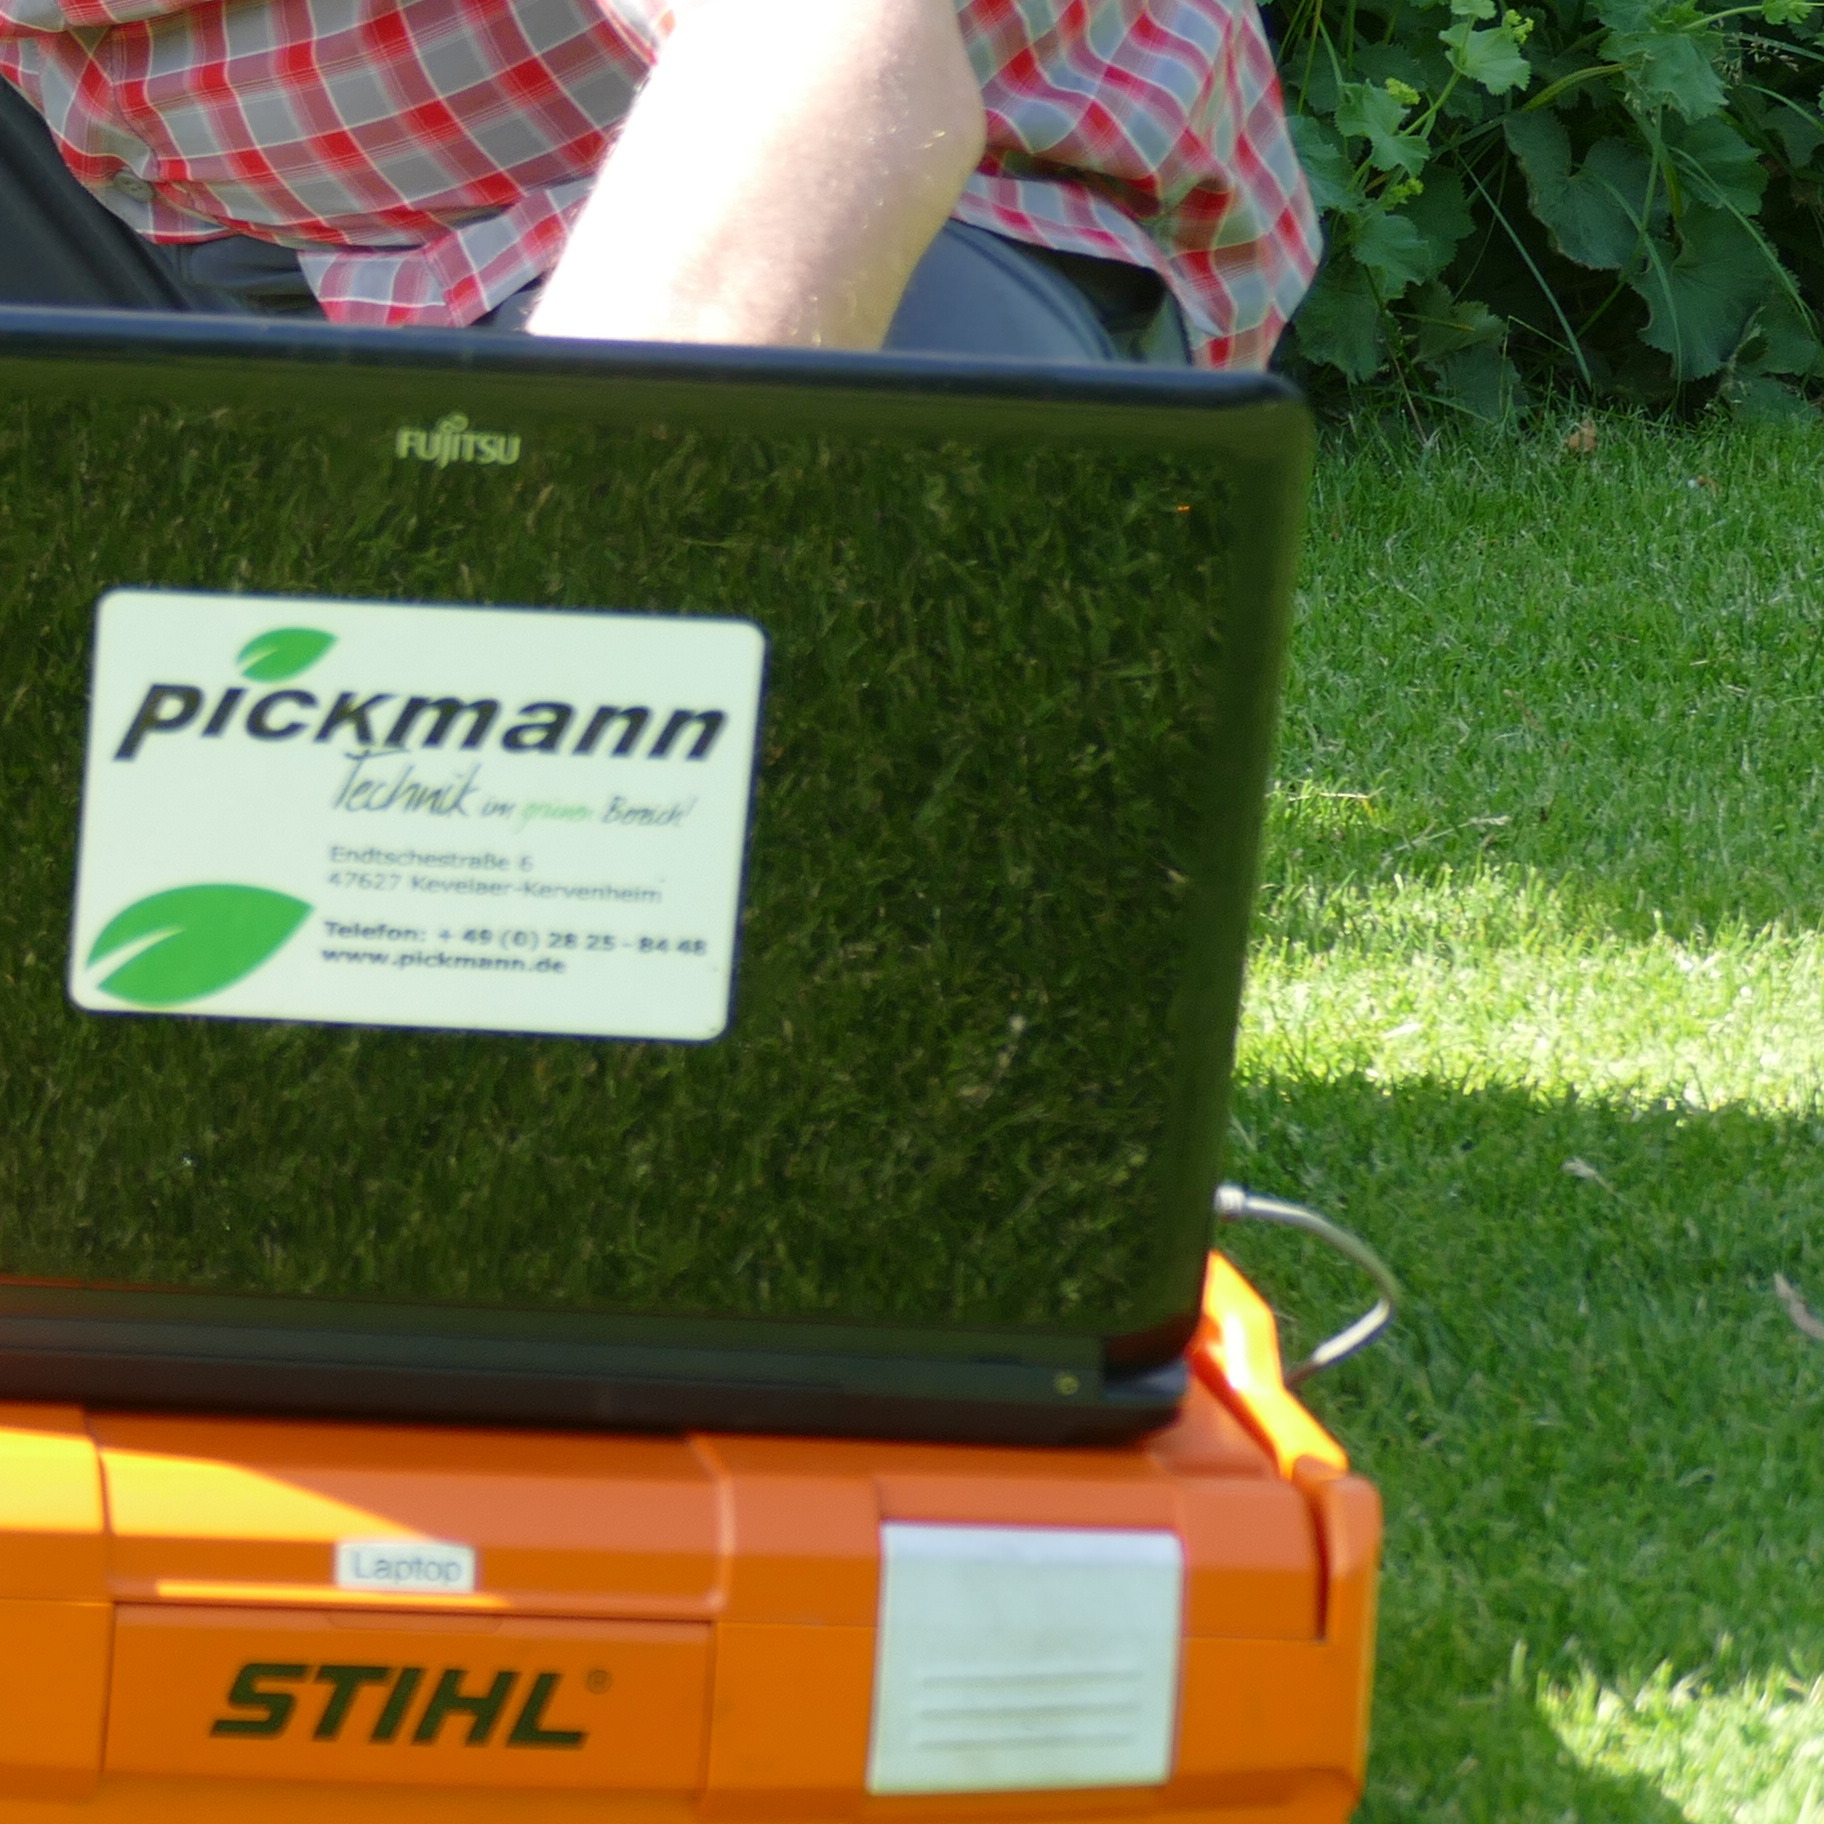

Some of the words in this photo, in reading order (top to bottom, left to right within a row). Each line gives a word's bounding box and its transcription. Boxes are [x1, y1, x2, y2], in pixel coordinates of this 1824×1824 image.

[395, 411, 522, 470] FUJITSU
[112, 682, 730, 764] pickmann
[333, 748, 482, 817] Technik
[328, 871, 403, 893] 47627
[323, 920, 427, 943] Telefon:
[461, 927, 494, 946] 49
[499, 927, 541, 951] (0)
[547, 931, 579, 950] 28
[585, 933, 616, 951] 25
[321, 948, 568, 974] www.pickmann.de
[351, 1550, 464, 1585] Laptop
[210, 1661, 590, 1751] STIHL
